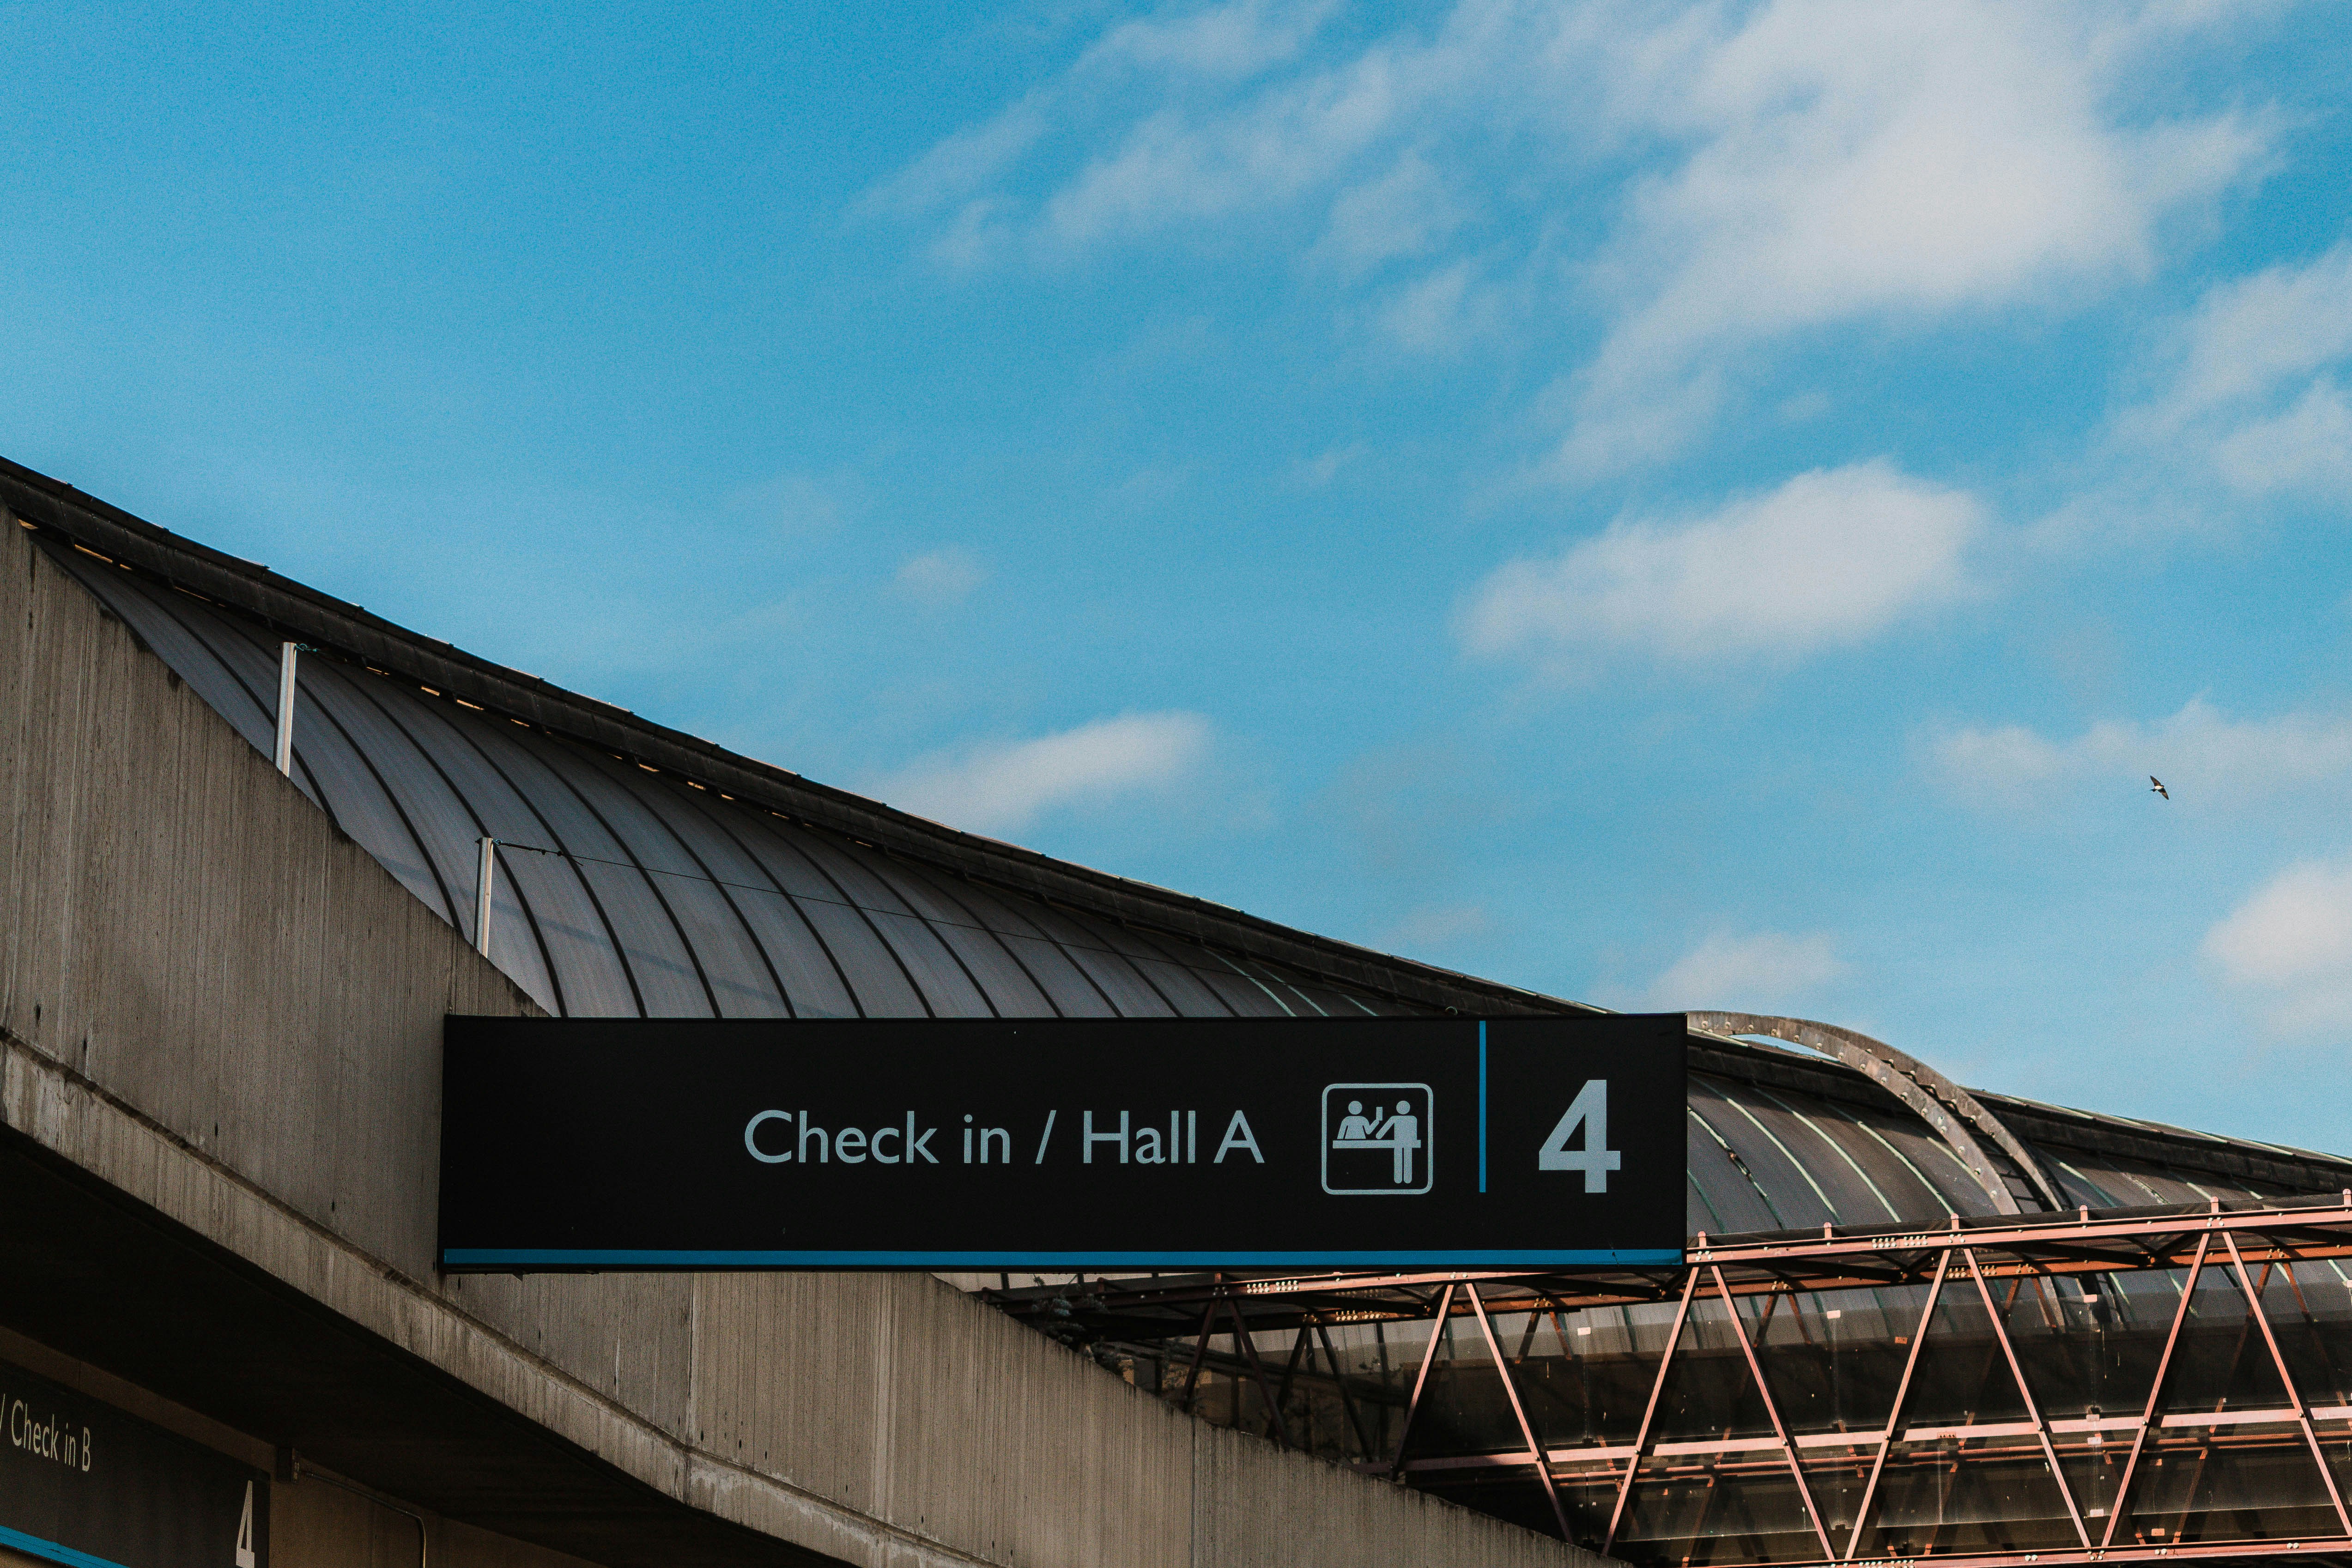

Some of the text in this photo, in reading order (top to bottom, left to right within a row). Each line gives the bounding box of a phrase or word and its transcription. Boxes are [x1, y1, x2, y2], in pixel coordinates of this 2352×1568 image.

[744, 1109, 1265, 1165] Check in / Hall A
[1538, 1079, 1621, 1194] 4
[11, 1399, 59, 1461] Check
[64, 1422, 76, 1467] in
[82, 1427, 91, 1472] B
[236, 1480, 255, 1568] 4
